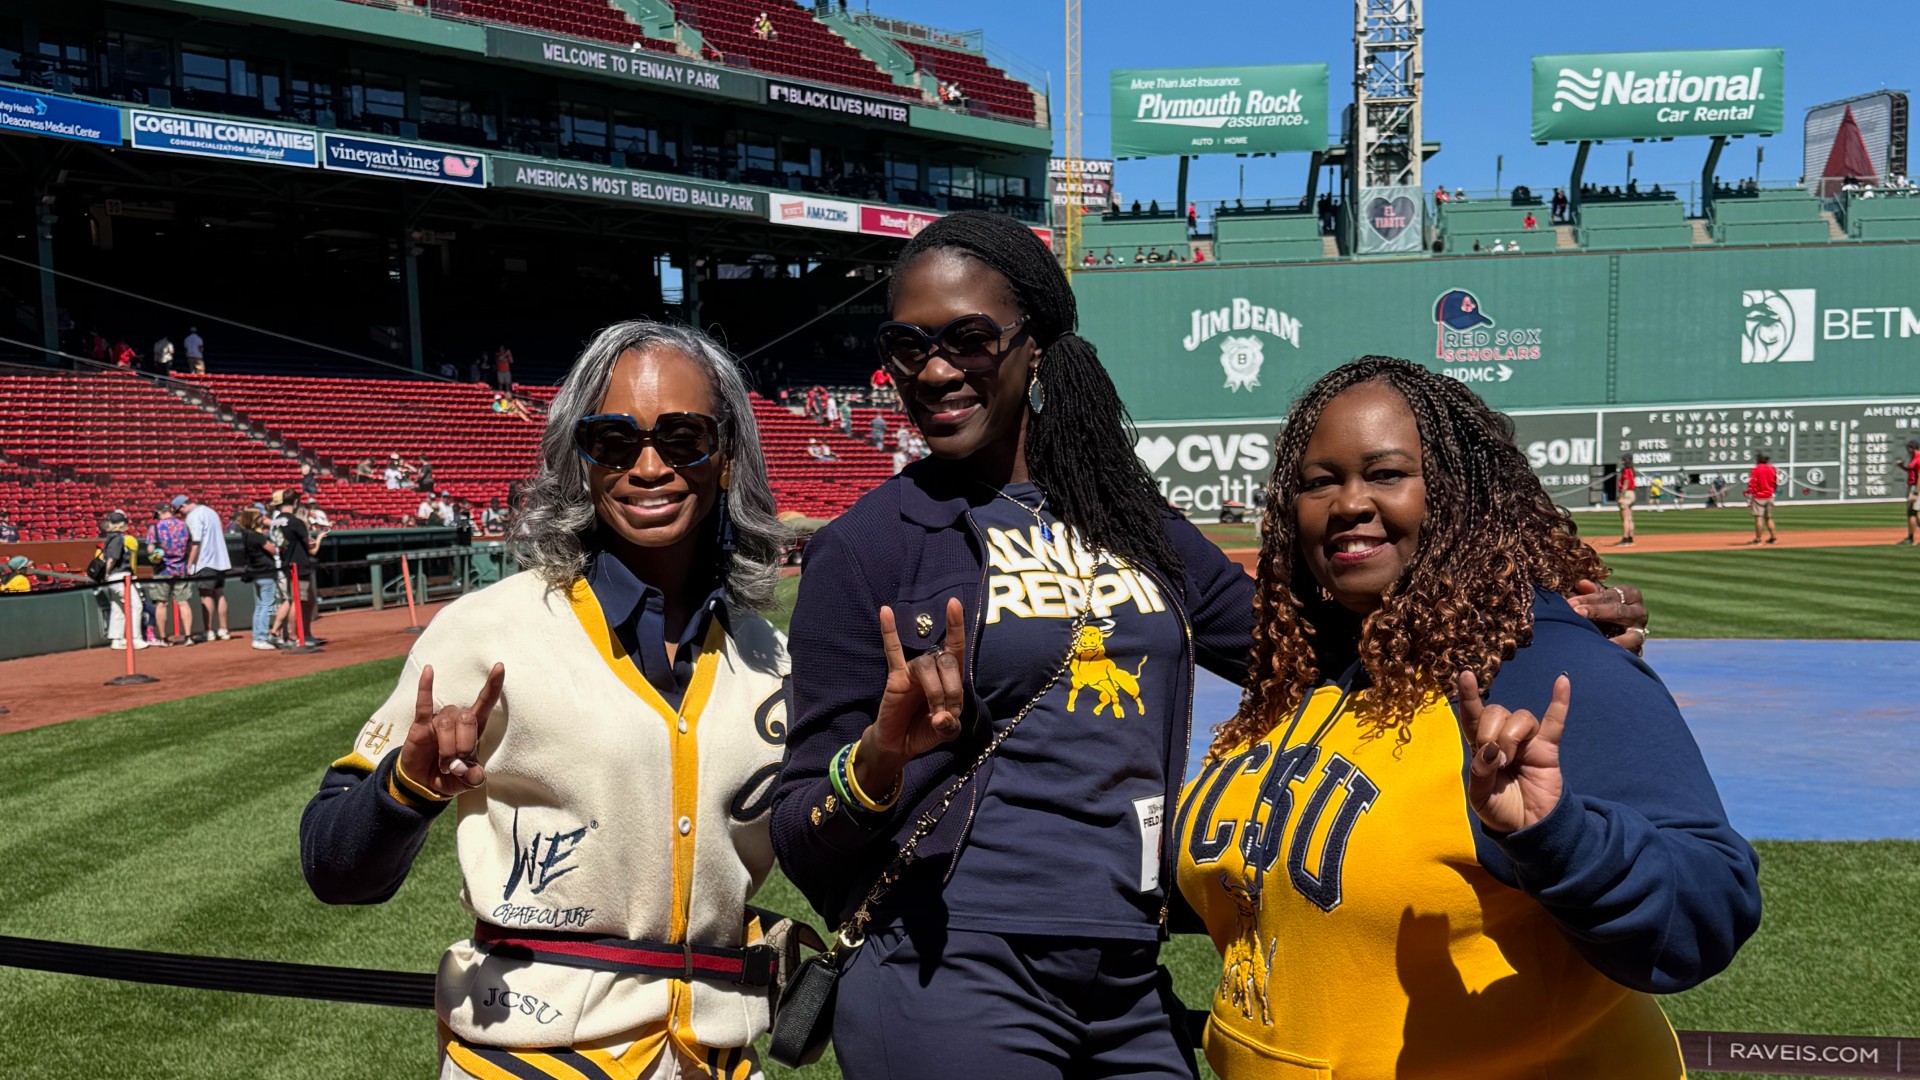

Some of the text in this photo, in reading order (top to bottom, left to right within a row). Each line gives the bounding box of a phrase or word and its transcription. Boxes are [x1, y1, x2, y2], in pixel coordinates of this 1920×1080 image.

[542, 42, 720, 90] WELCOME TO FENWAY PARK
[1131, 79, 1155, 90] More
[1156, 78, 1178, 89] Than
[1179, 78, 1196, 88] Just
[789, 88, 907, 122] BLACK LIVES MATTER
[1137, 88, 1303, 120] Plymouth Rock
[1657, 104, 1755, 122] Car Rental
[3, 113, 44, 130] Deaconess
[45, 120, 74, 135] Medical
[75, 126, 100, 138] Center
[134, 115, 315, 150] COGHLIN COMPANIES
[170, 138, 244, 153] COMMERCIALIZATION
[1191, 136, 1248, 146] AUTO HOME
[330, 143, 399, 167] vineyard
[399, 152, 441, 171] vines
[516, 166, 753, 211] AMERICA'S MOST BELOVED BALLPARK
[806, 205, 848, 223] AMAZING
[1183, 297, 1300, 352] JIM BEAM
[1444, 328, 1542, 347] RED SOX
[1443, 346, 1541, 362] SCHOLARS
[1648, 410, 1794, 424] FENWAY PARK
[1177, 433, 1270, 473] CVS
[1633, 452, 1671, 464] BOSTON
[503, 808, 588, 901] WE
[483, 988, 563, 1025] JCSU
[1730, 1042, 1879, 1064] RAVEIS.COM
